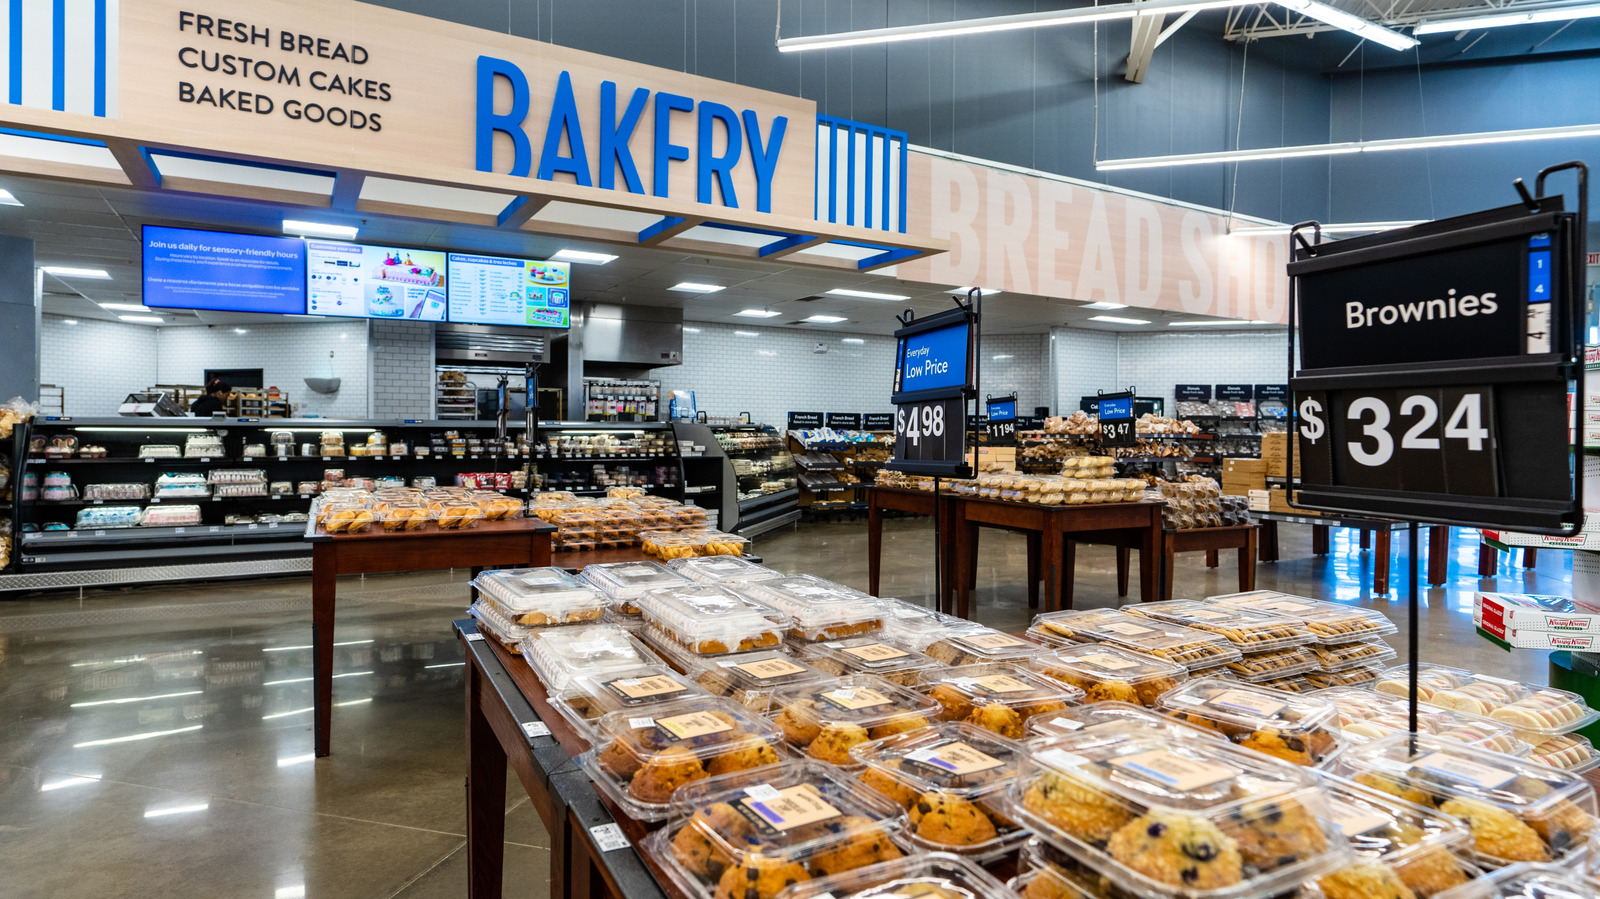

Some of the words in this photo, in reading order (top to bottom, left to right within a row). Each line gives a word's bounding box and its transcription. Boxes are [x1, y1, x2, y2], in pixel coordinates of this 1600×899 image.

[178, 10, 270, 47] FRESH
[280, 30, 369, 65] BREAD
[178, 47, 301, 87] CUSTOM
[309, 71, 392, 102] CAKES
[178, 81, 274, 115] BAKED
[283, 100, 382, 132] GOODS
[475, 55, 789, 214] BAKERY
[149, 240, 166, 249] Join
[178, 242, 198, 252] daily
[199, 243, 211, 252] for
[212, 246, 275, 258] sensory-friendly
[276, 250, 298, 259] hours
[930, 157, 1163, 311] BREAD
[1179, 210, 1287, 325] SHO
[1346, 289, 1499, 329] Brownies
[906, 345, 930, 359] Everyday
[906, 362, 923, 379] Low
[924, 359, 949, 375] Price
[1299, 396, 1325, 444] $
[1549, 619, 1568, 627] Krispy
[1551, 637, 1571, 646] Krispy
[1571, 638, 1590, 646] Kreme
